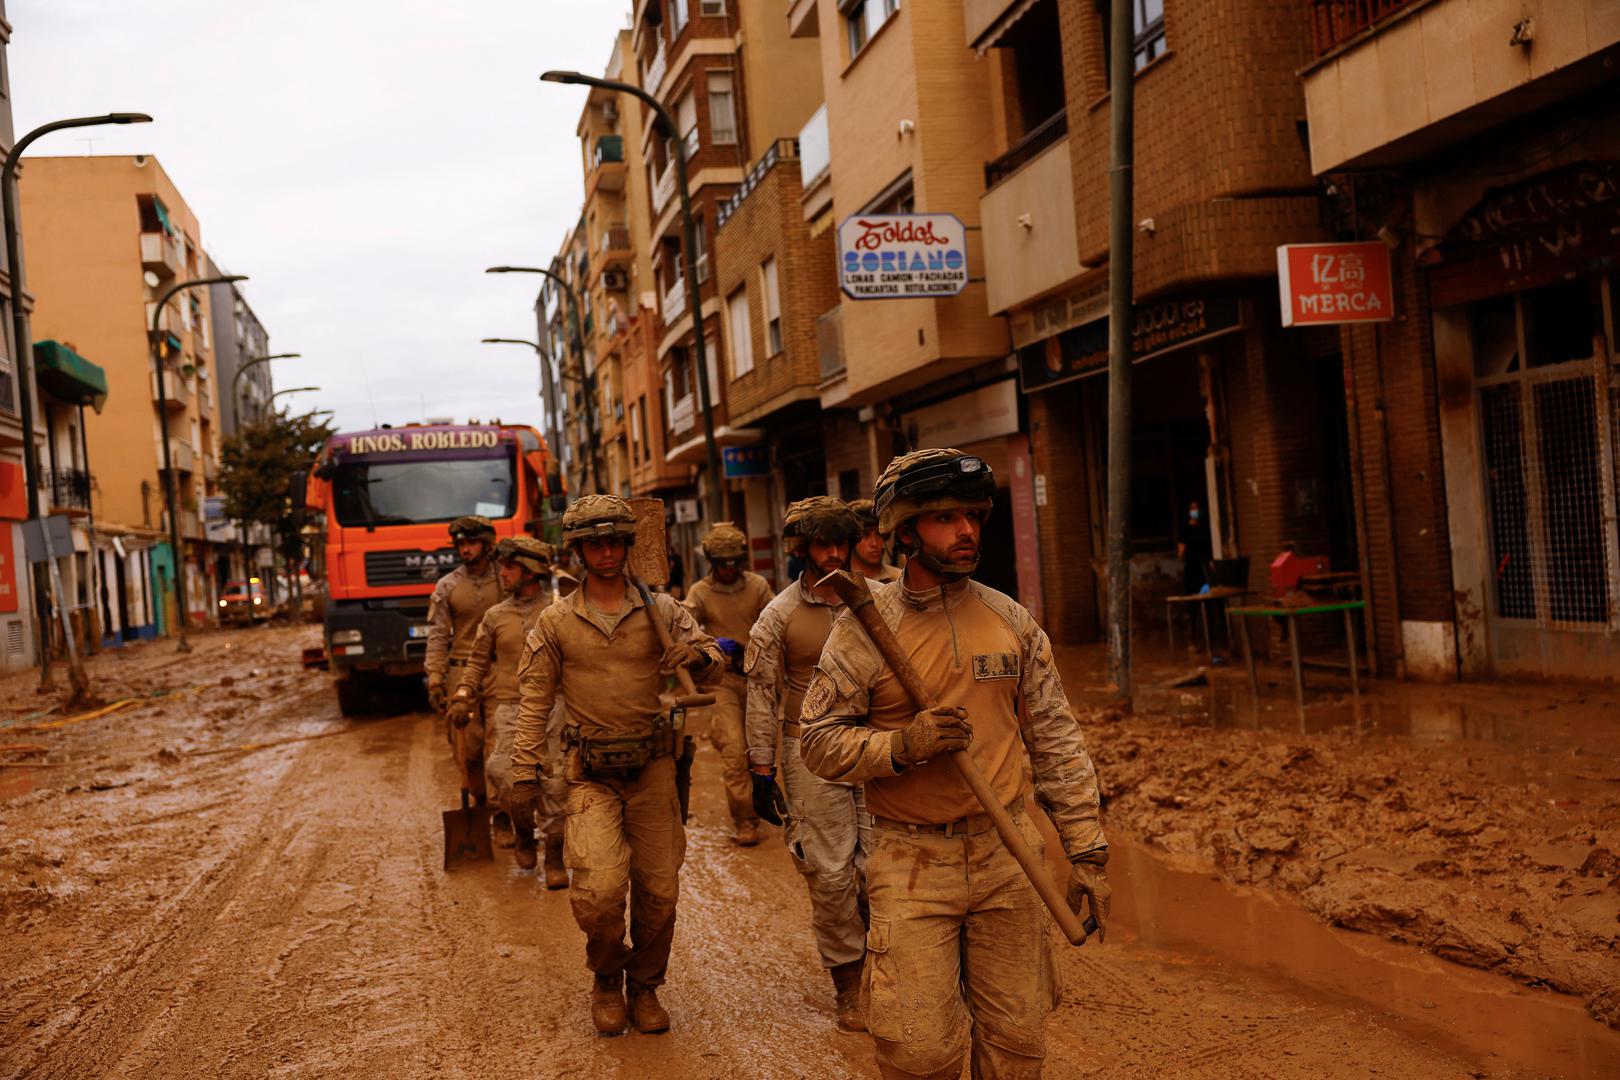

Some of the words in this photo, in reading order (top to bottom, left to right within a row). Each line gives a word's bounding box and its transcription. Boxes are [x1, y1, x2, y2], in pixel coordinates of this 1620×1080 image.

[855, 220, 950, 250] Toldos
[844, 250, 963, 272] SORIANO
[846, 273, 875, 284] LONAS
[855, 284, 898, 294] PANCARTAS
[904, 282, 957, 293] ROTULACIONES
[1299, 291, 1382, 315] MERCA
[351, 433, 407, 454] HNOS.
[411, 430, 498, 450] ROBLEDO
[406, 554, 454, 566] MAN
